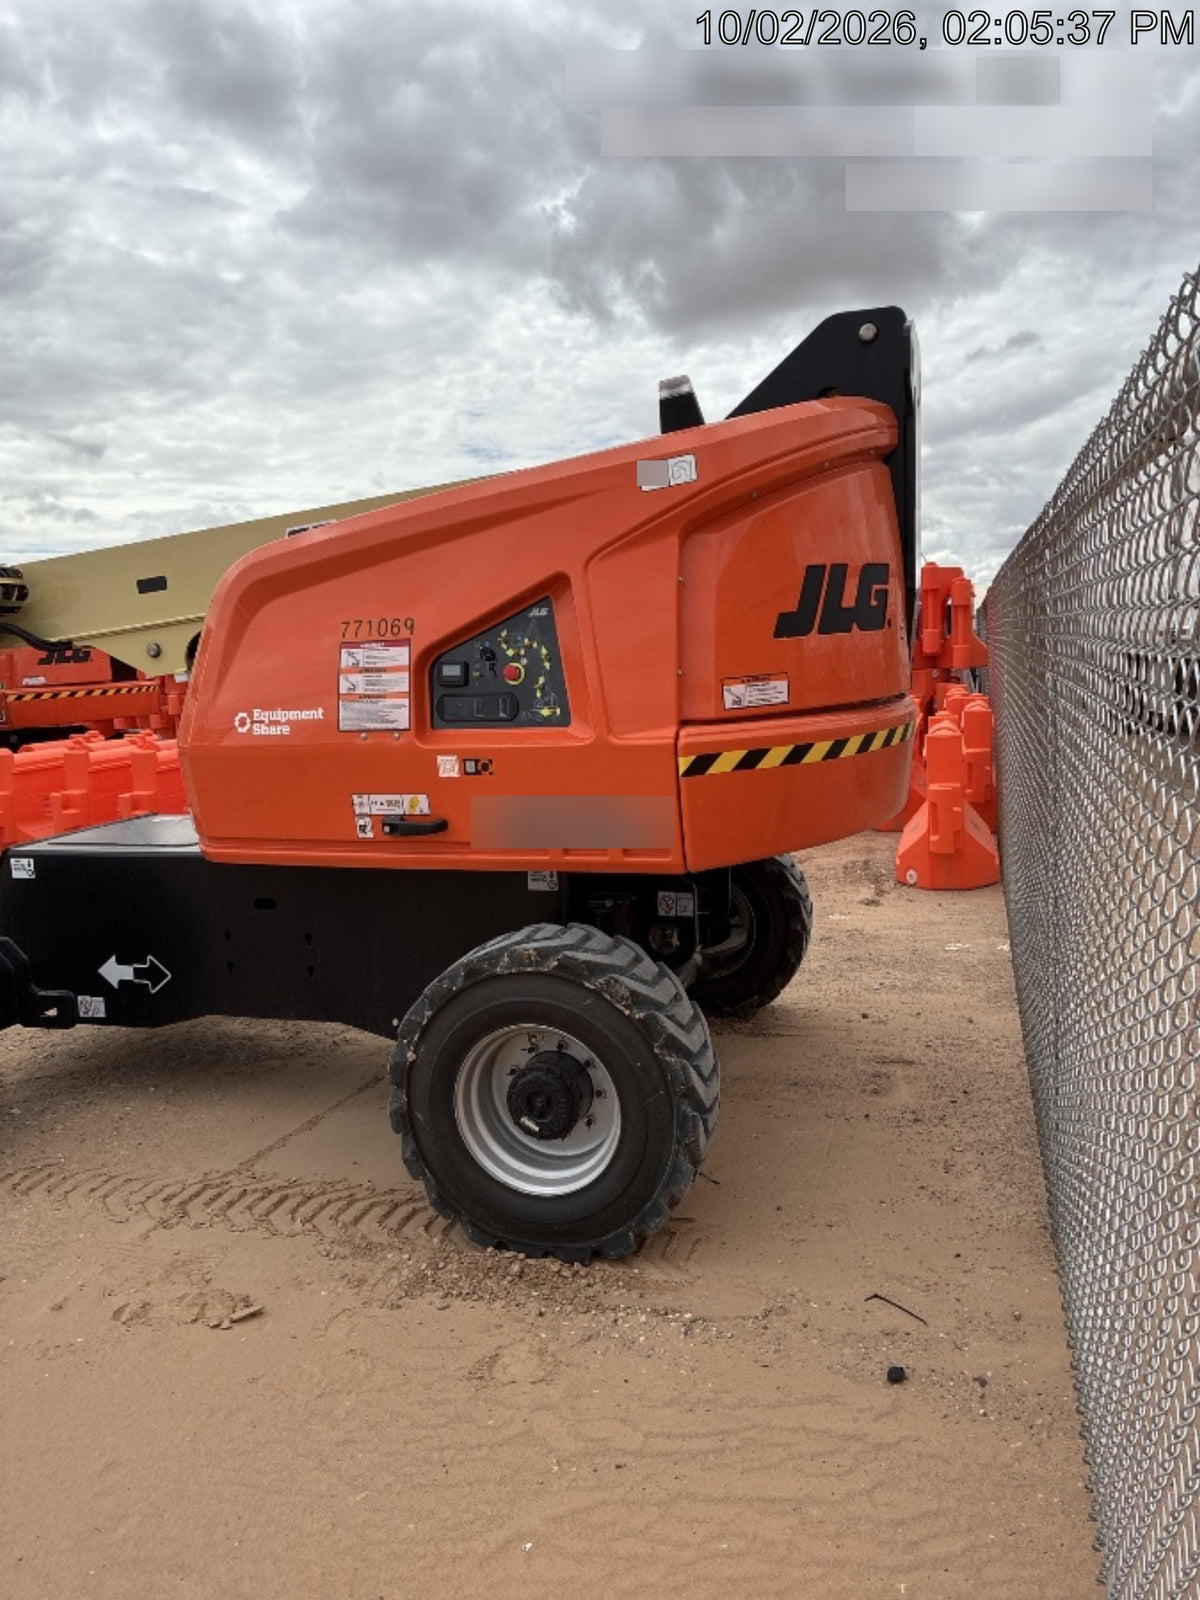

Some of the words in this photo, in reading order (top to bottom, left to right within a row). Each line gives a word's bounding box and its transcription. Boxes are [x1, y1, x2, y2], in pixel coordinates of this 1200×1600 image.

[773, 562, 890, 639] JLG
[340, 617, 416, 638] 771069
[252, 707, 324, 724] Equipment
[252, 723, 291, 735] Share
